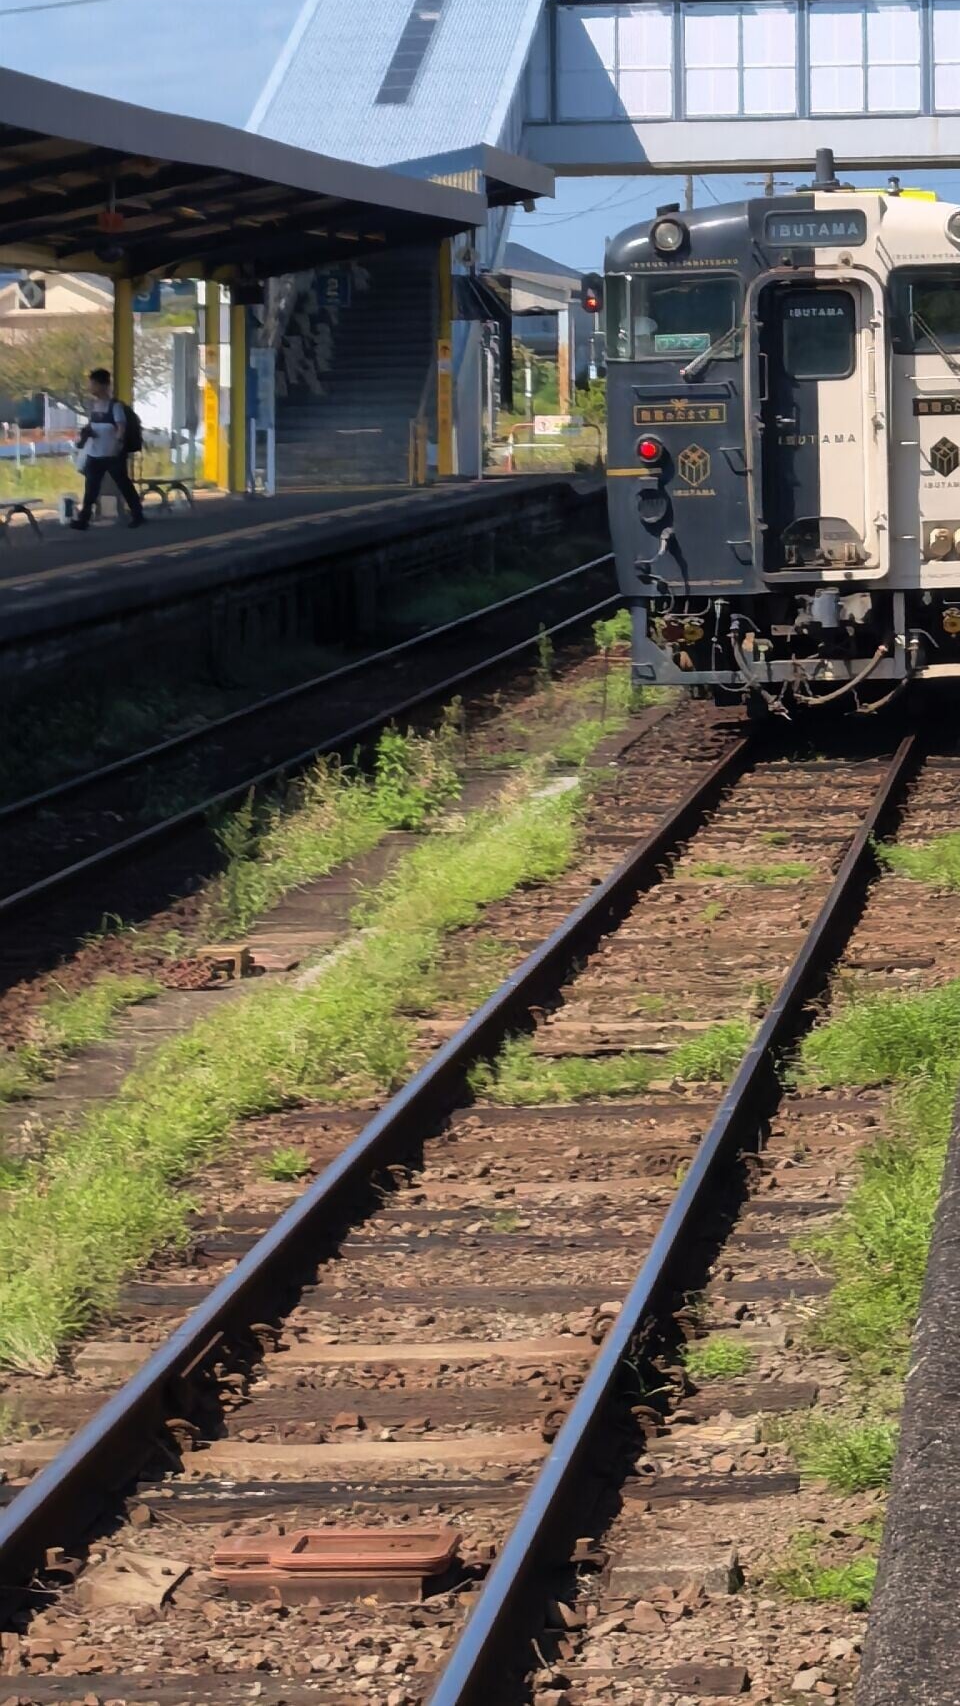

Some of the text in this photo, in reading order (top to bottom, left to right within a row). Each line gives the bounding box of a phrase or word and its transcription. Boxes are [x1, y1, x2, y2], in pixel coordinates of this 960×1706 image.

[771, 222, 859, 237] IBUTAMA
[789, 307, 844, 317] IBUTAMA
[778, 433, 856, 445] IBUTAMA
